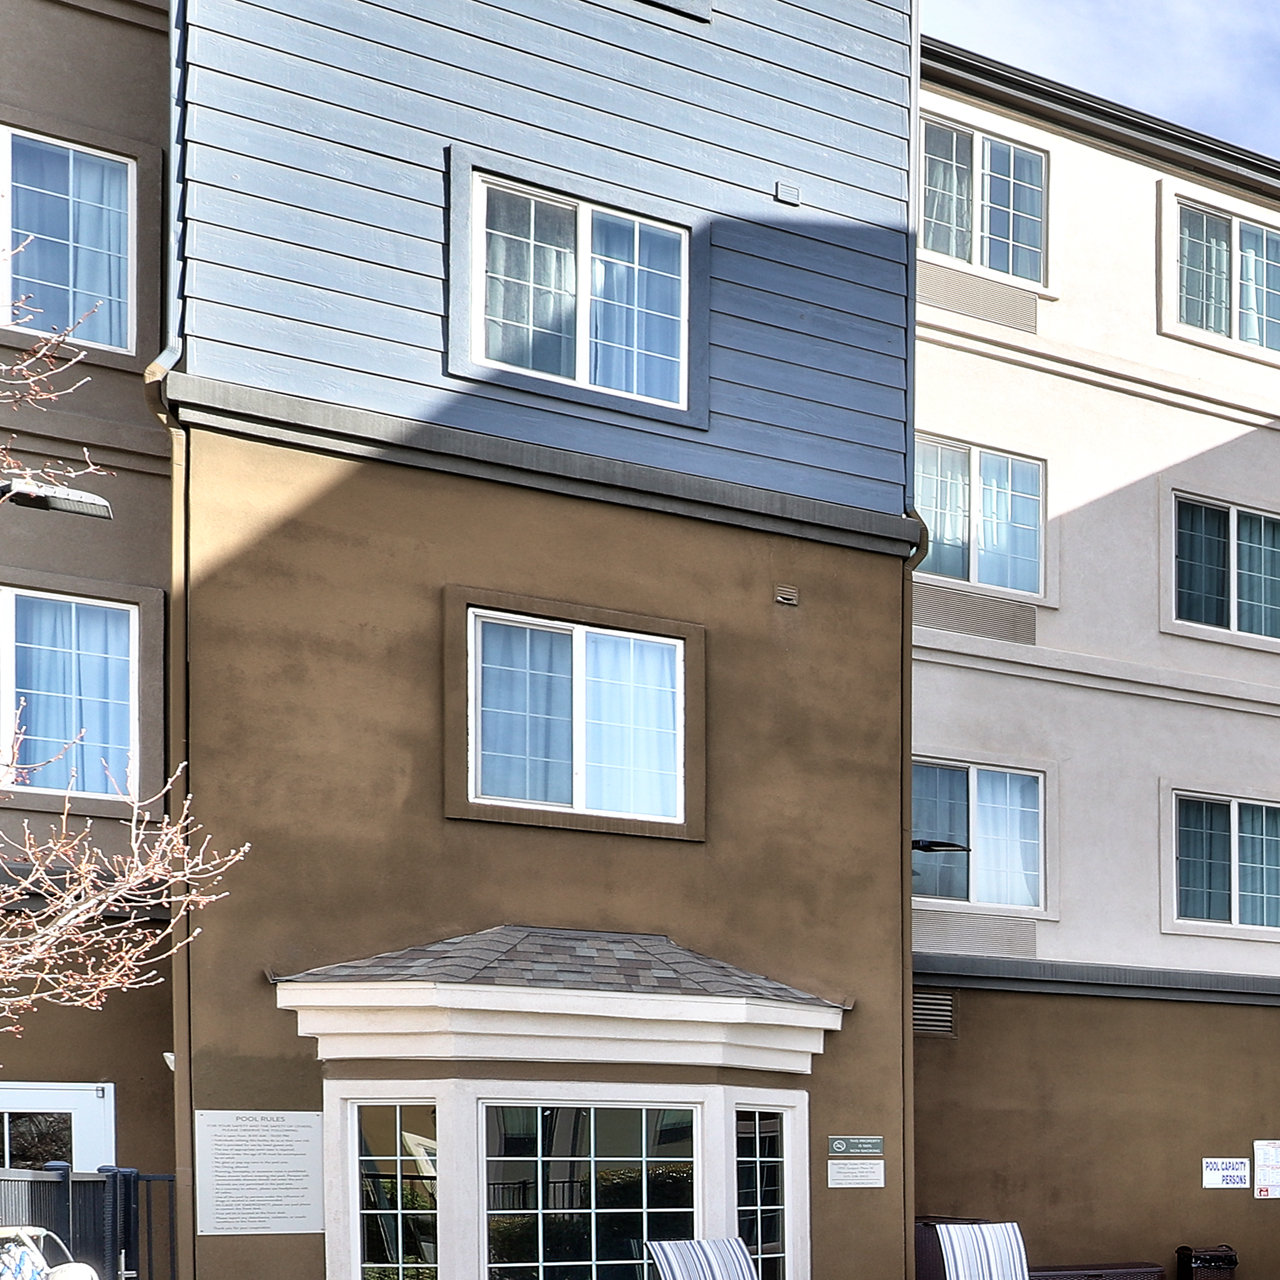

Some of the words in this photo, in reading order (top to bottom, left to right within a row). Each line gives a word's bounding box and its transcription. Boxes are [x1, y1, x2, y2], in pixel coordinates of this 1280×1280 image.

[1205, 1161, 1220, 1171] POOL
[1221, 1161, 1246, 1171] CAPACITY
[1221, 1174, 1247, 1185] PERSONS
